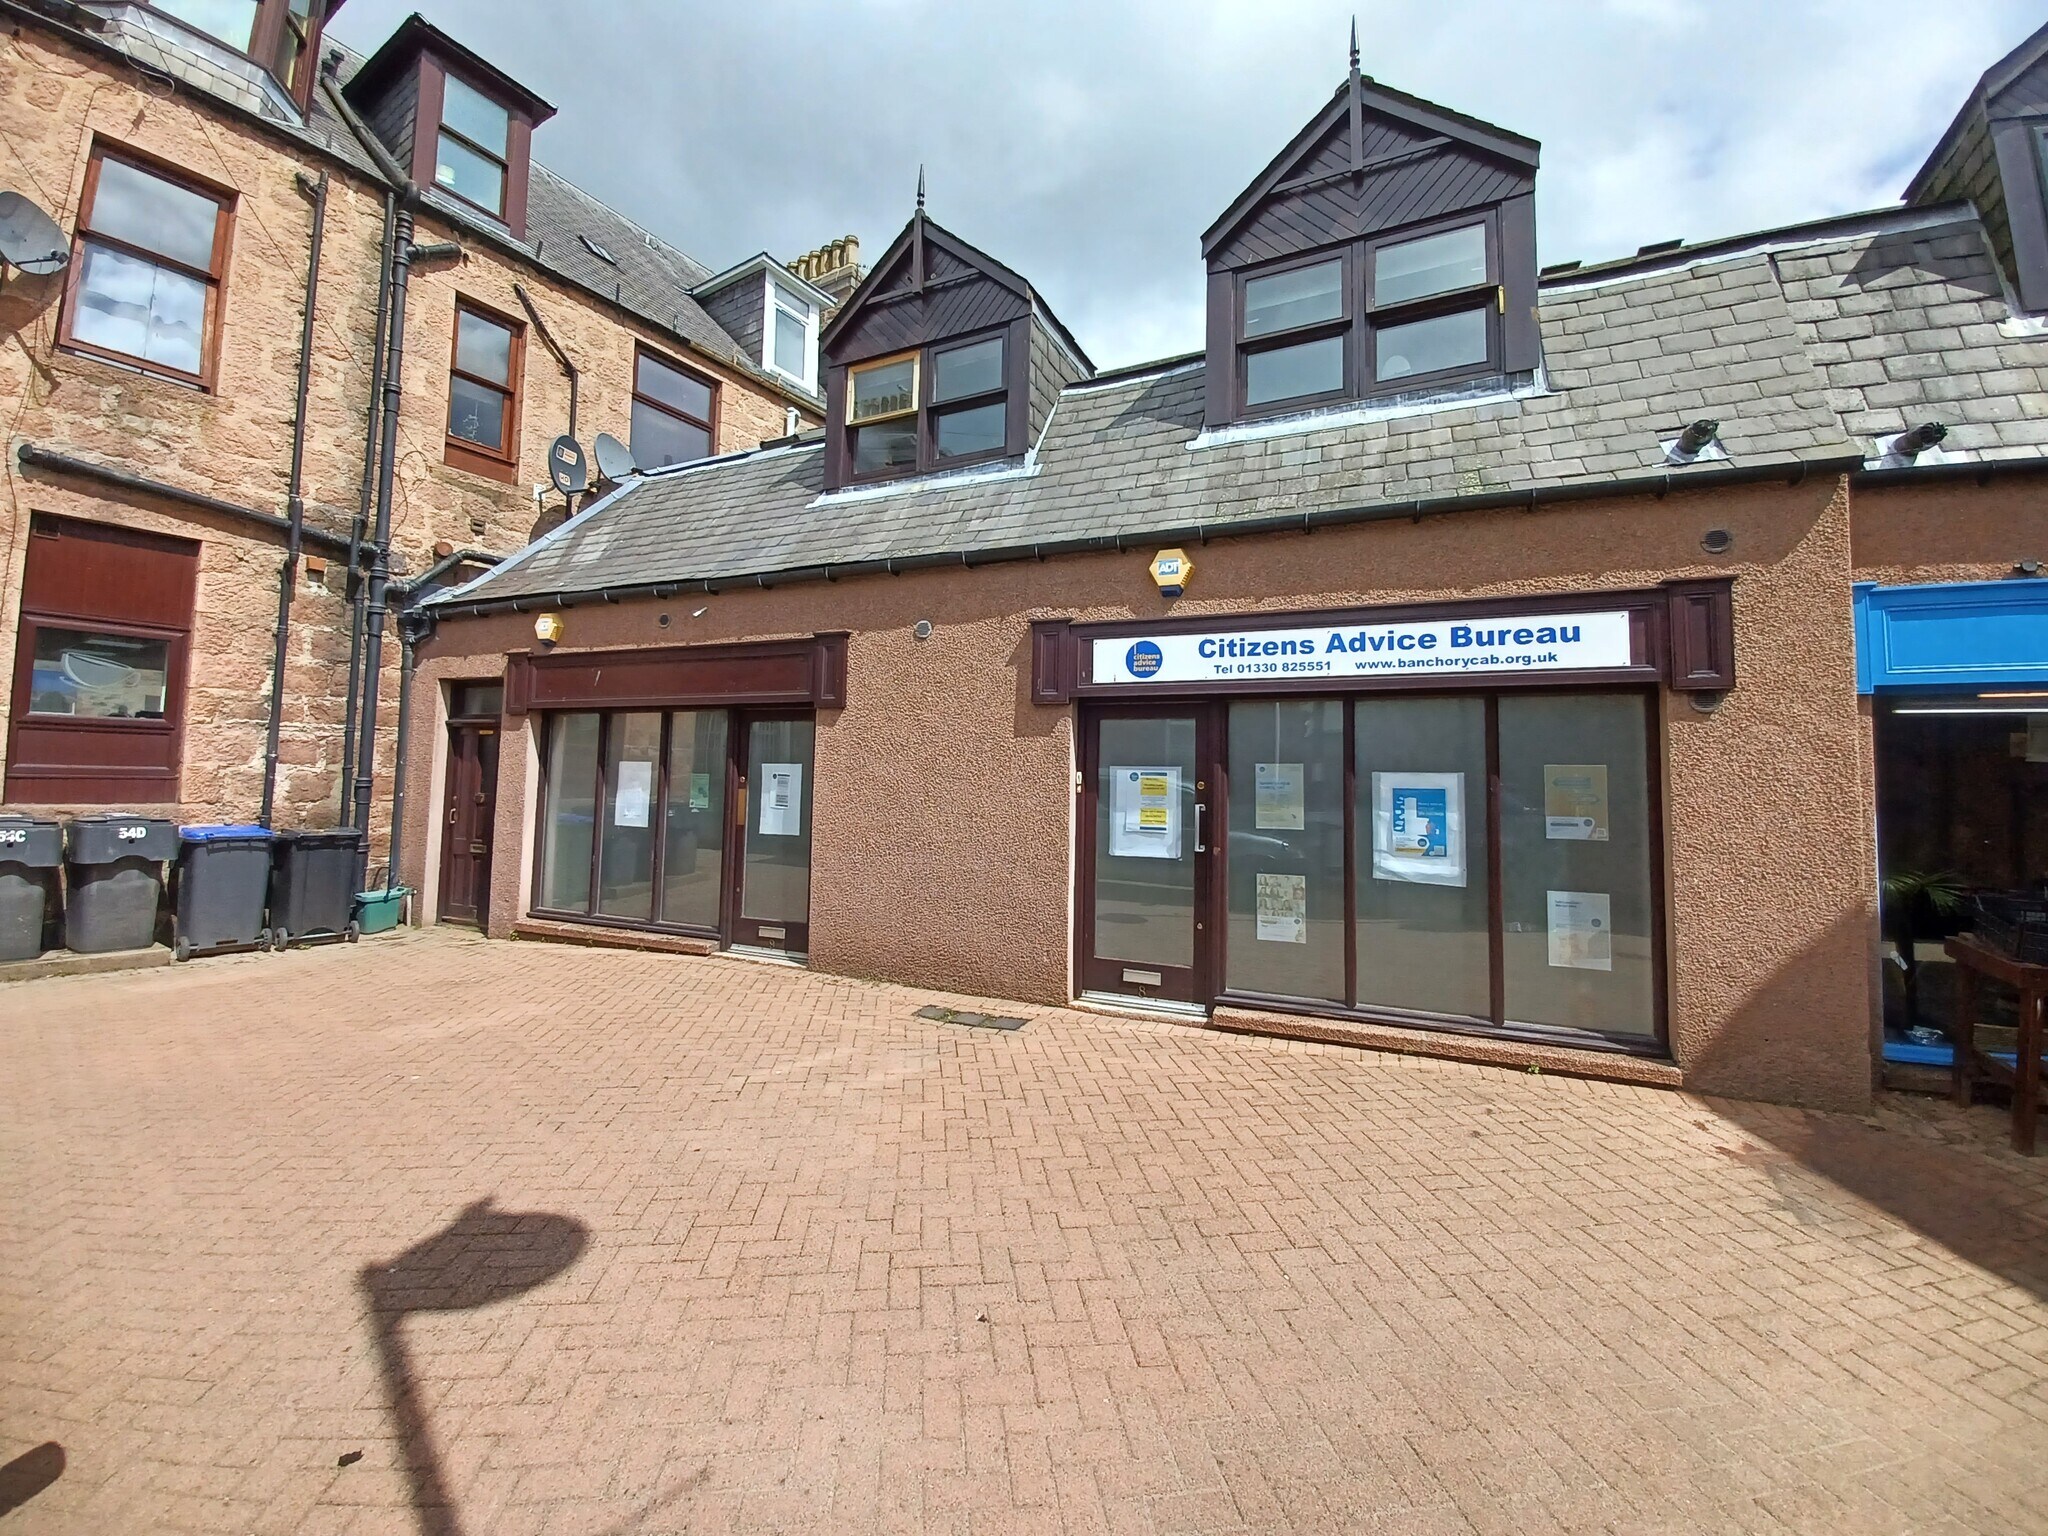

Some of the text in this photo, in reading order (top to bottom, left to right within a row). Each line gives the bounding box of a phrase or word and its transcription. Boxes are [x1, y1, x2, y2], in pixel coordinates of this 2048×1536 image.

[1159, 562, 1178, 573] ADT
[1198, 625, 1581, 658] Citizens Advice Bureau
[1133, 653, 1160, 661] citizens
[1214, 652, 1558, 674] Tel 01330 825551 www.banchorycab.org.uk
[118, 827, 147, 839] 54D
[769, 939, 776, 949] 9
[1138, 985, 1147, 997] 8
